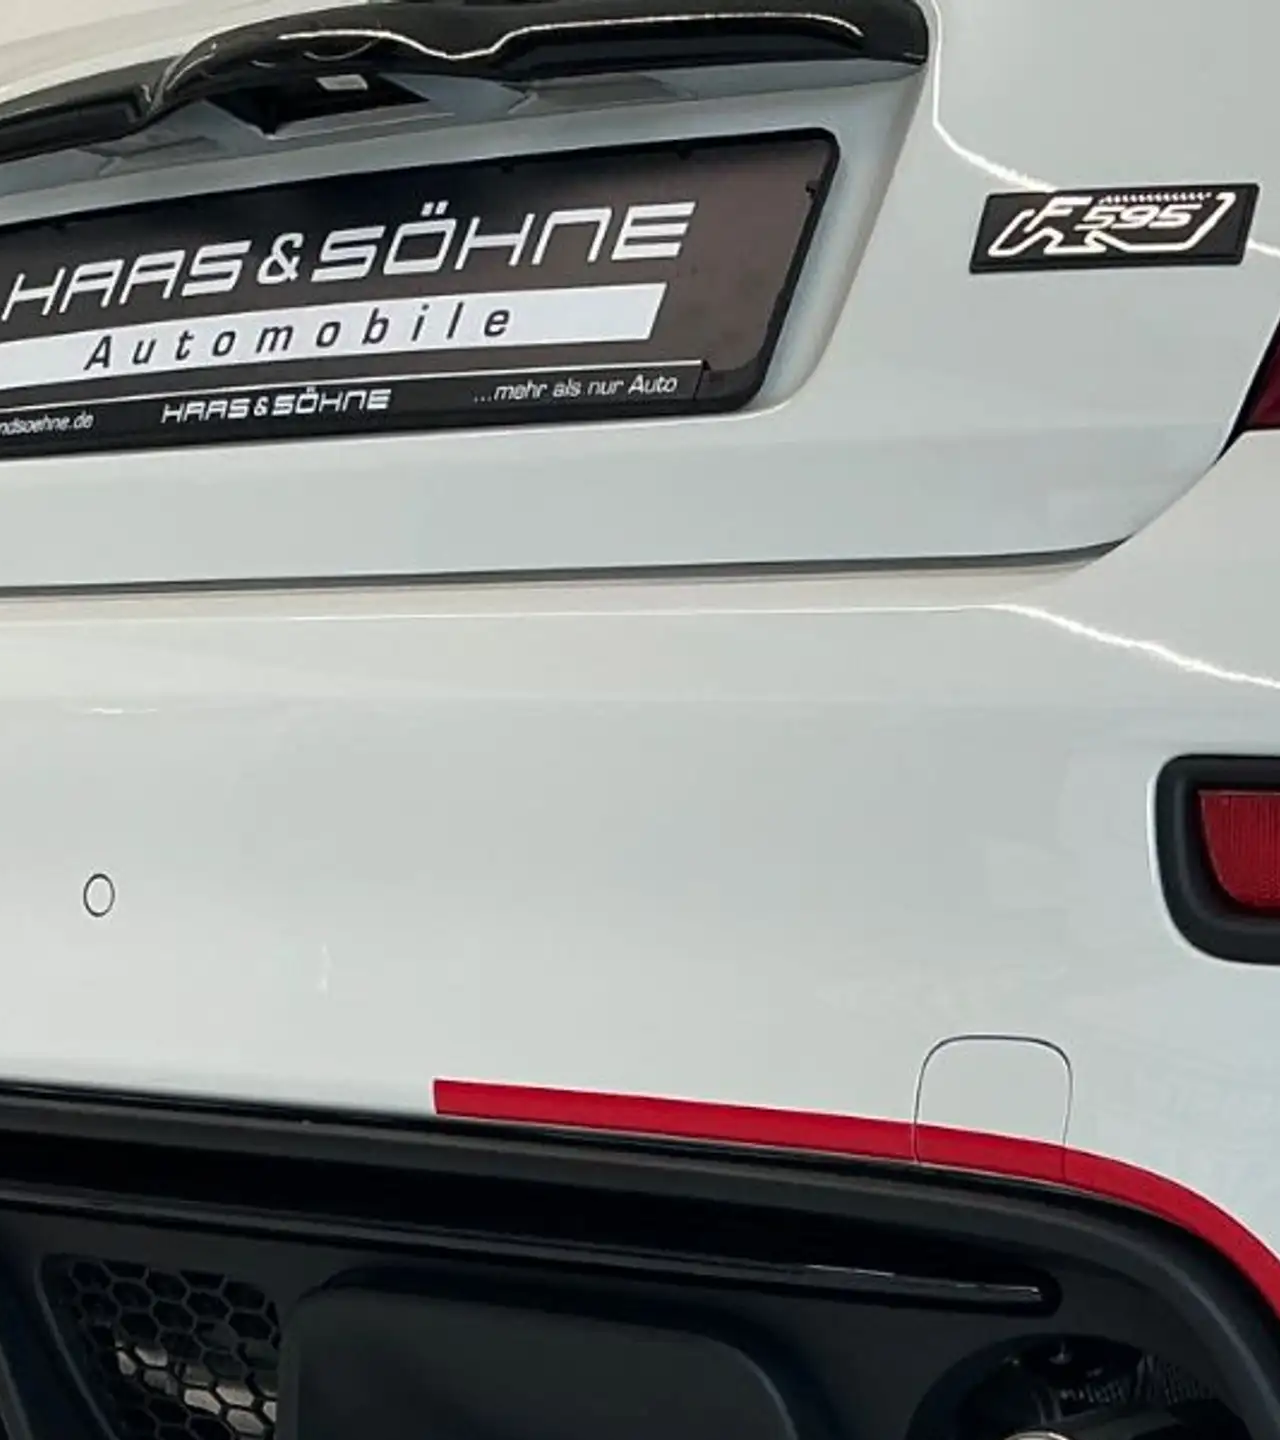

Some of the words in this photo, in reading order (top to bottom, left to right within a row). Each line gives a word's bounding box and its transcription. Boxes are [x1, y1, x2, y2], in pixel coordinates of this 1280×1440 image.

[83, 302, 511, 371] Automobile
[552, 377, 582, 397] als
[587, 379, 624, 395] nur
[628, 373, 678, 395] Auto
